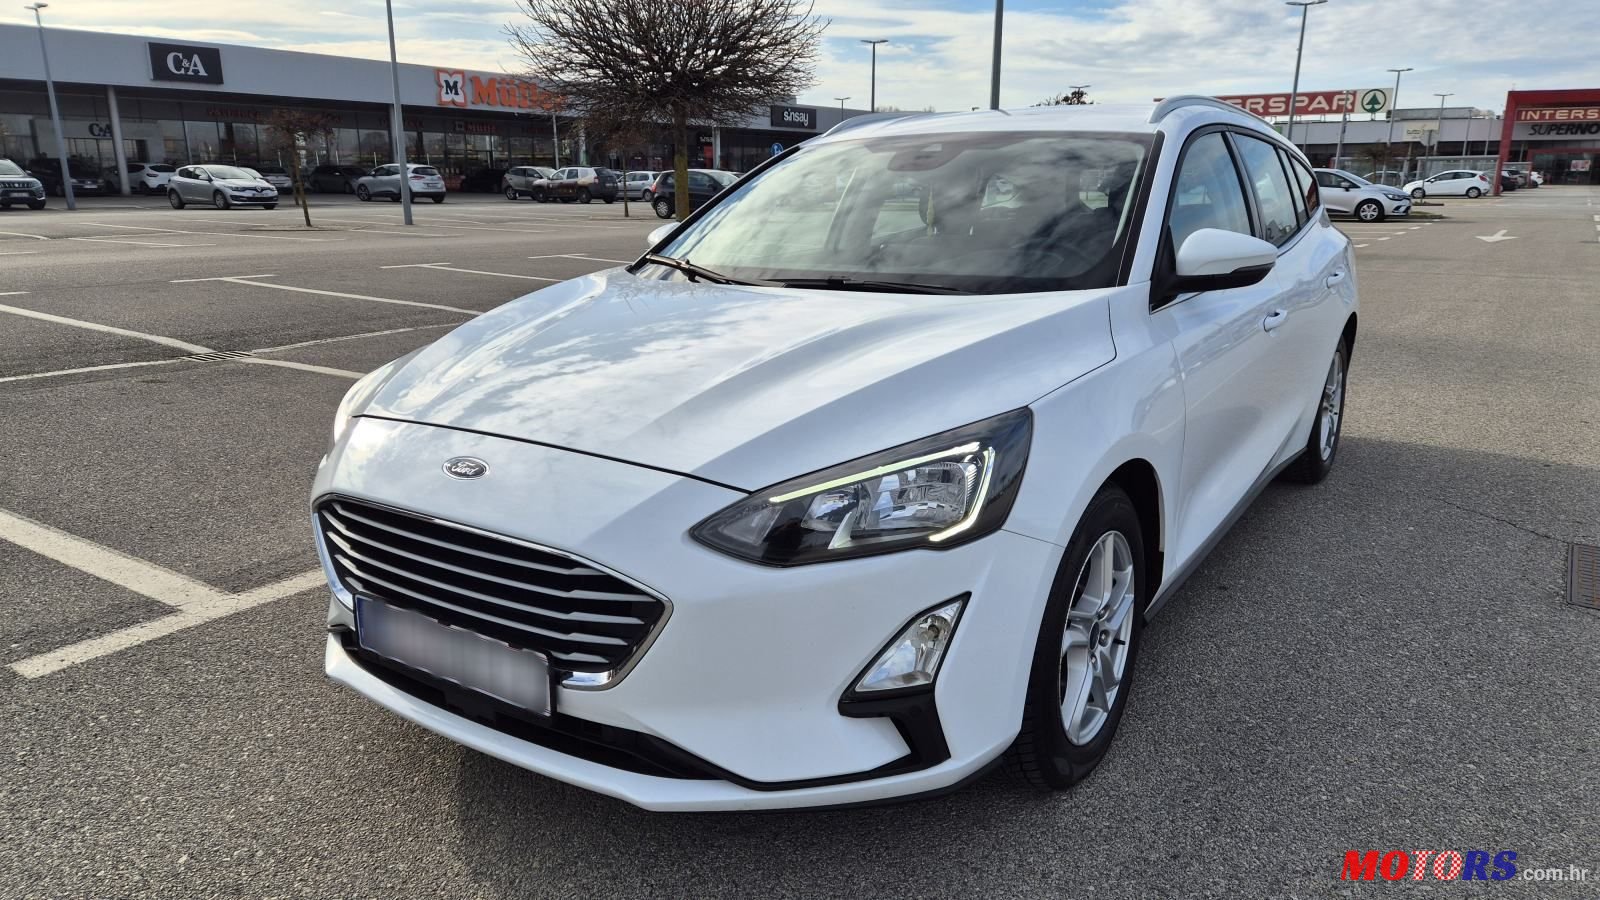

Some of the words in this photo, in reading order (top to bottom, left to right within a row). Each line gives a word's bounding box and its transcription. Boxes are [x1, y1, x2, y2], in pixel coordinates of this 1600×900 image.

[166, 52, 208, 76] C&A
[444, 79, 460, 96] M
[783, 108, 809, 127] sinsay
[1520, 108, 1599, 120] INTERS
[1528, 123, 1600, 136] SUPERNO
[451, 461, 479, 475] Ford
